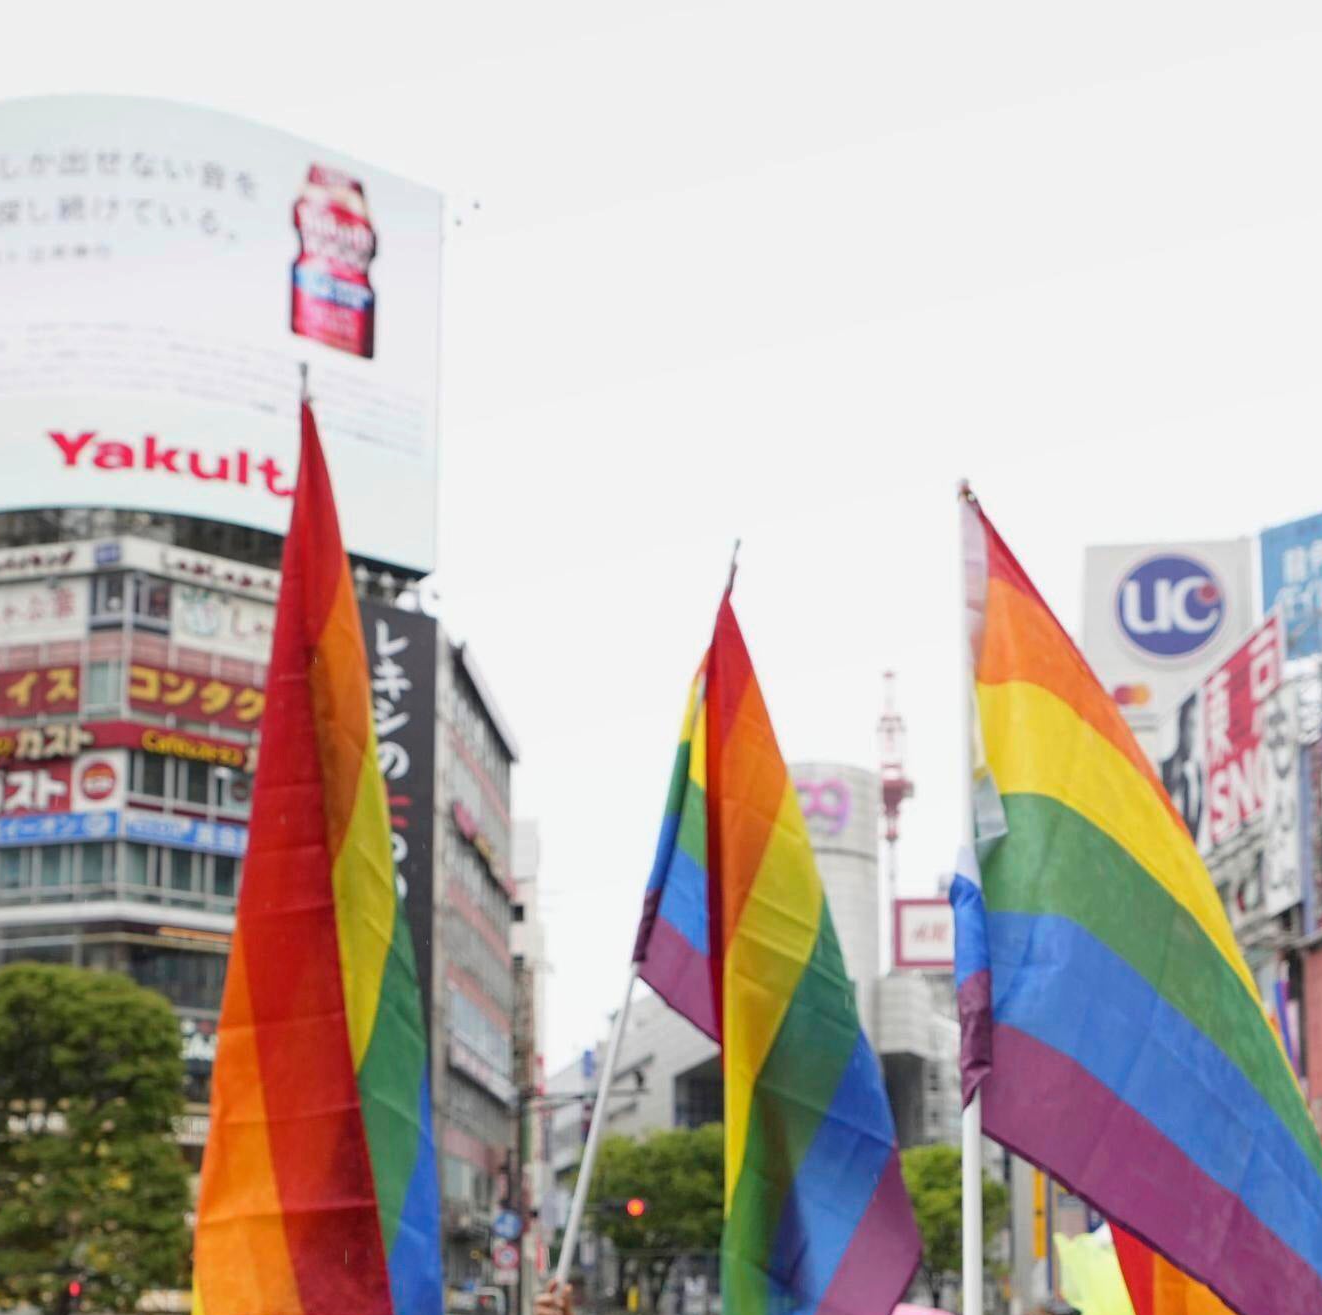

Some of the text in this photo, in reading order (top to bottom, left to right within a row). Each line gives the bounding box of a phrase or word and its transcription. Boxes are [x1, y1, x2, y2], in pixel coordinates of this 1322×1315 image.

[47, 429, 294, 497] Yakult
[1122, 575, 1220, 634] UC
[16, 723, 95, 760] ガスト
